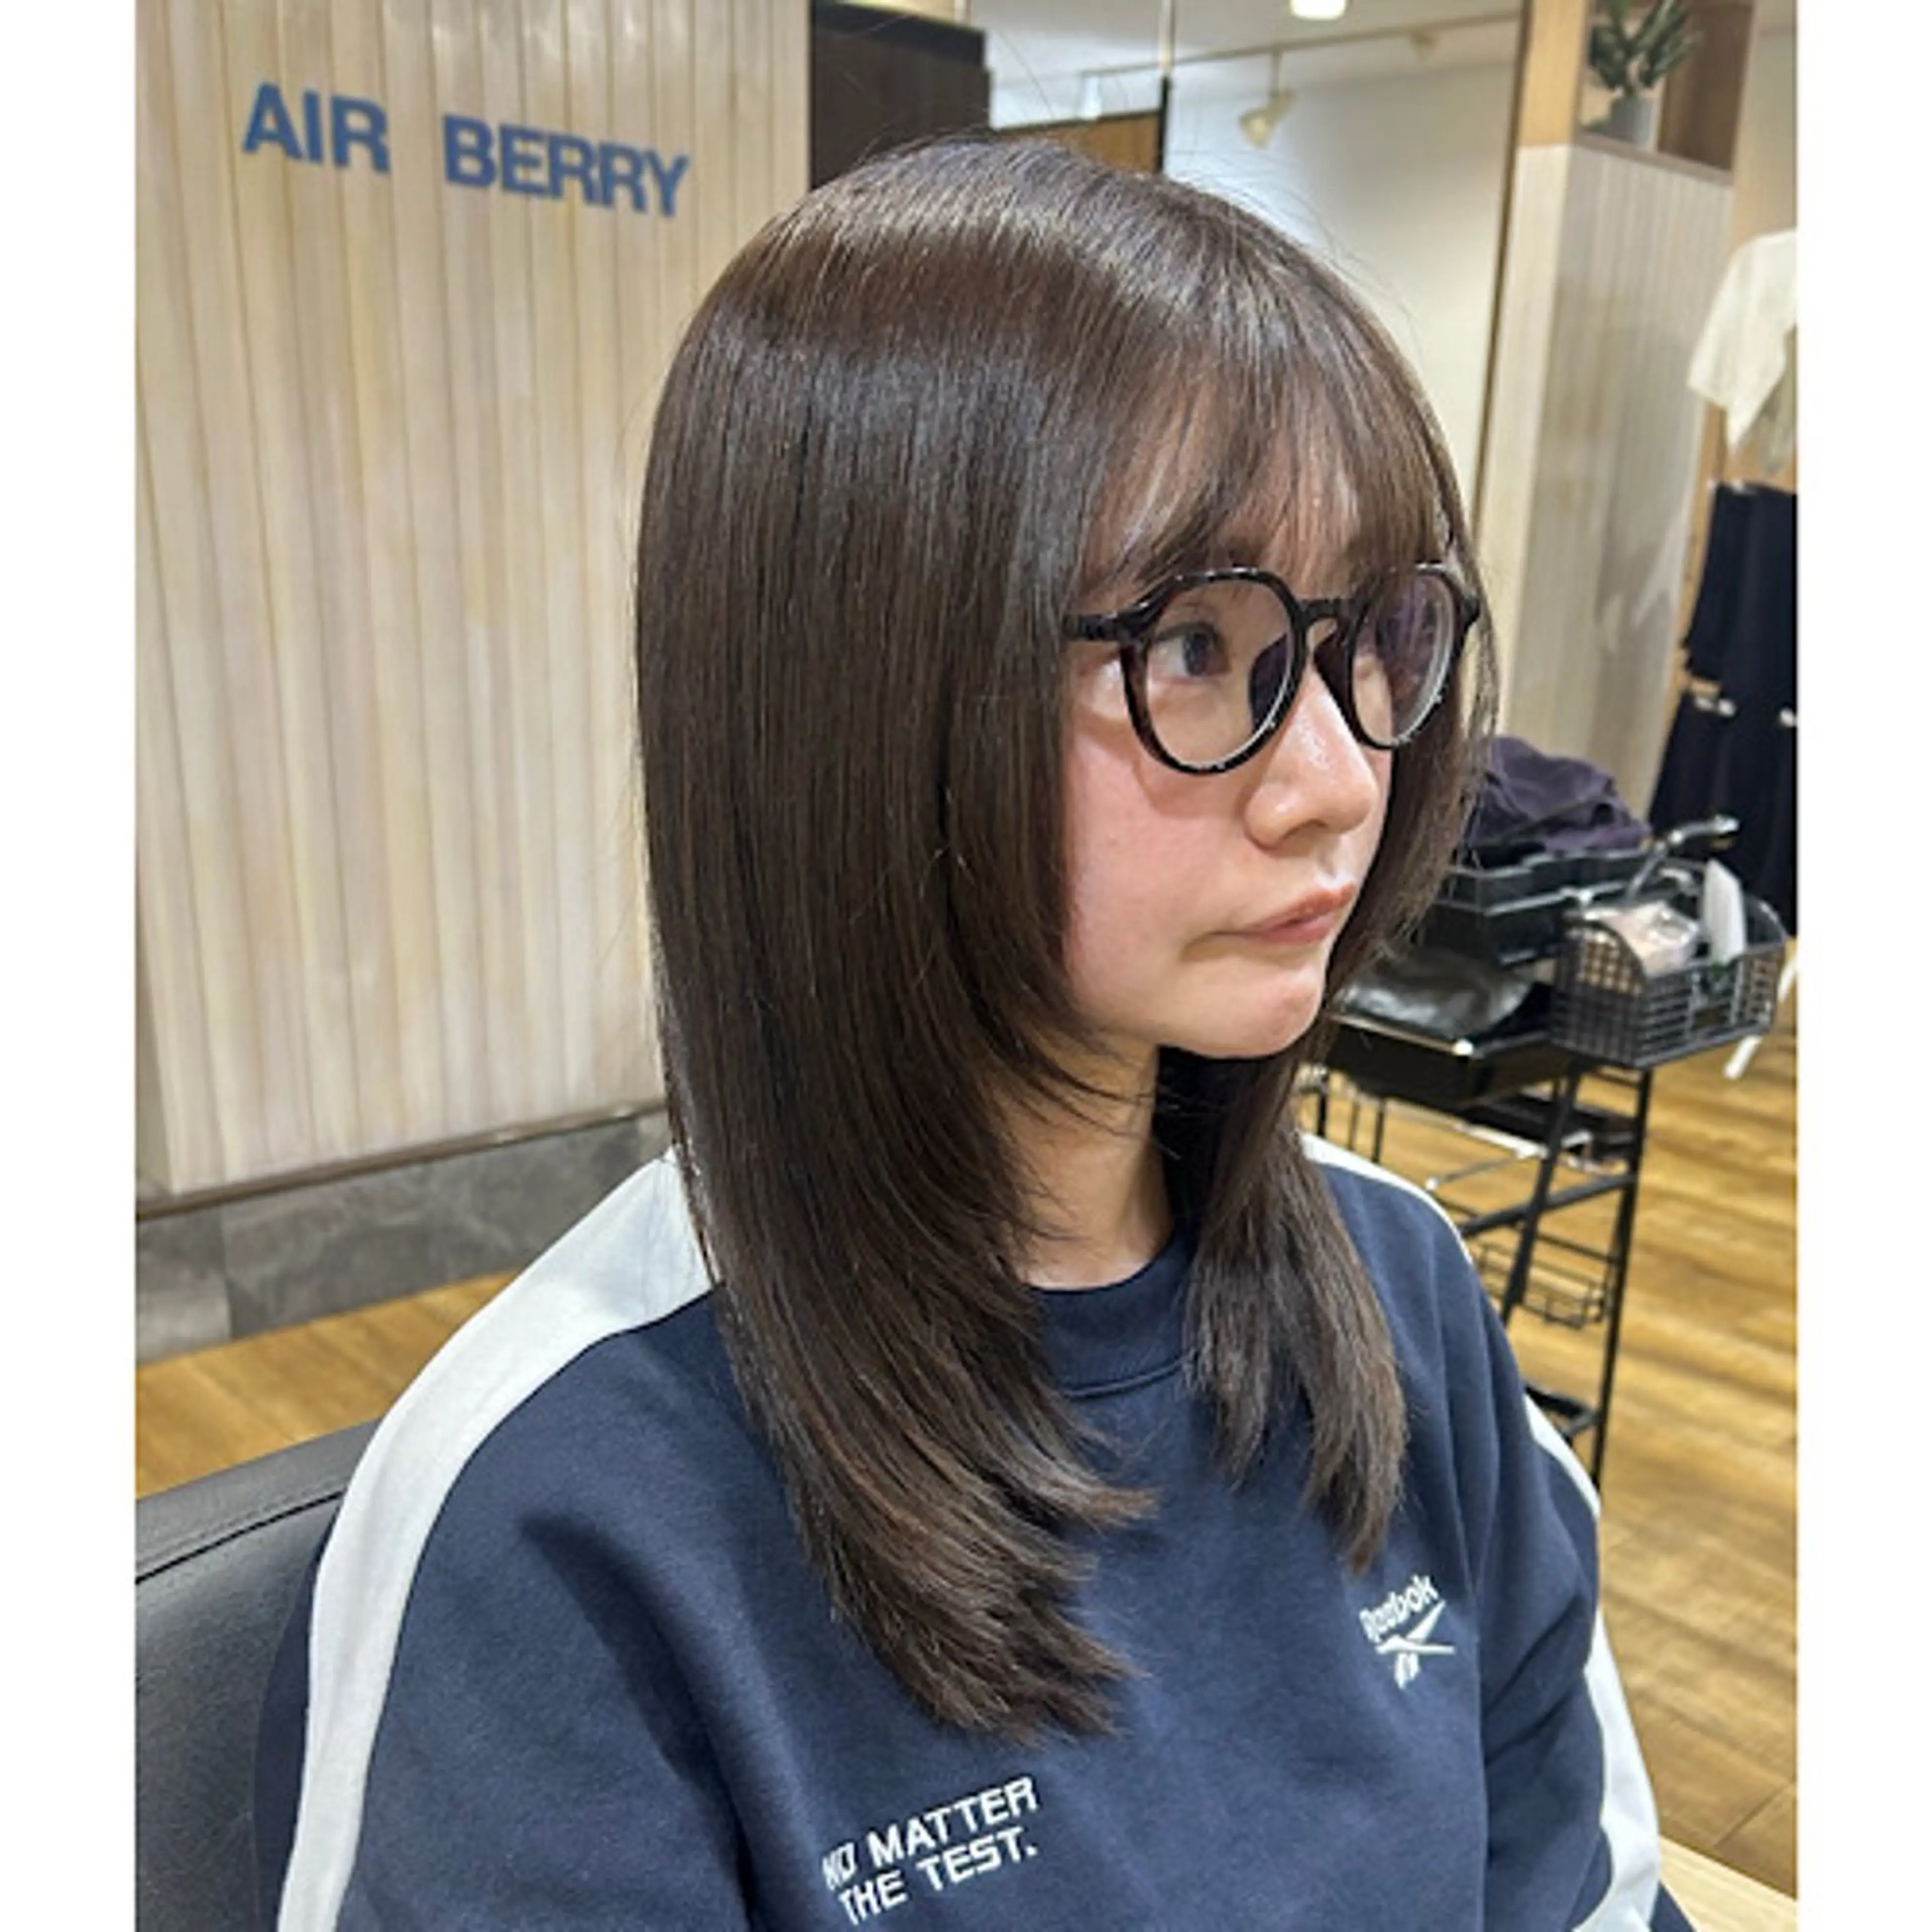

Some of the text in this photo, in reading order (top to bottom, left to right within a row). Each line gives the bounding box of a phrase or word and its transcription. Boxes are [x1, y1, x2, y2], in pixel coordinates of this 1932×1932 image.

[243, 82, 690, 218] AIR BERRY
[822, 1776, 1038, 1891] NO MATTER
[838, 1826, 1038, 1925] THE TEST.
